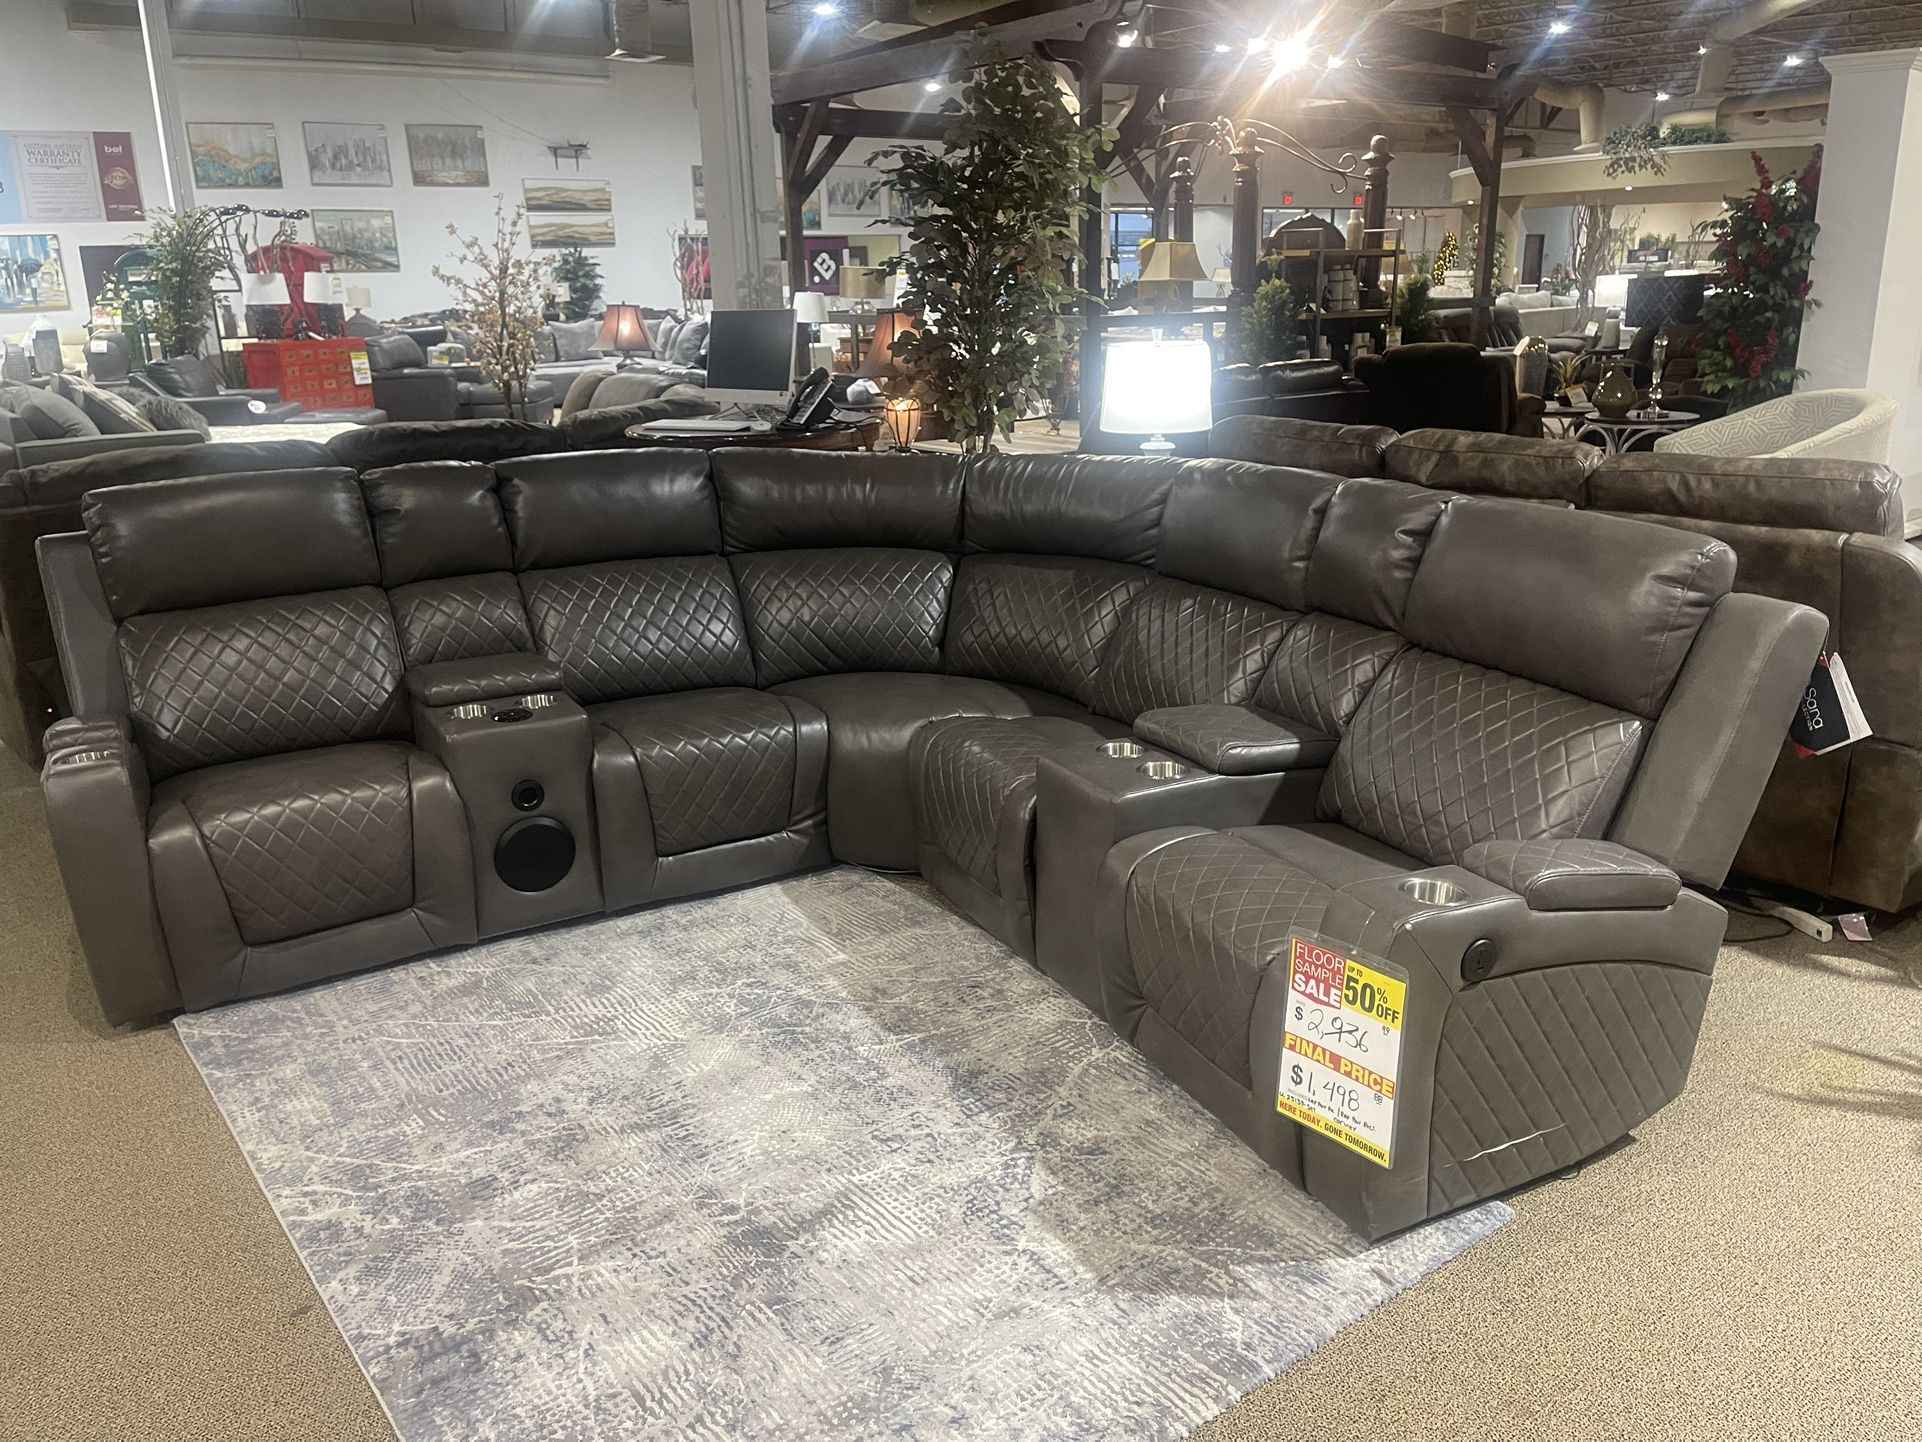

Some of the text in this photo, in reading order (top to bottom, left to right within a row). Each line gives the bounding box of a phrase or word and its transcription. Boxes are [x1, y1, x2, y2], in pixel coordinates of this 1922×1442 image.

[26, 149, 82, 159] WARRANTY
[28, 157, 82, 166] CERTIFICATE
[1804, 688, 1823, 728] Sara
[1296, 943, 1345, 973] FLOOR
[1348, 965, 1363, 977] UP TO
[1295, 960, 1344, 988] SAMPLE
[1294, 973, 1342, 1008] SALE
[1376, 1007, 1400, 1024] OFF
[1284, 1033, 1335, 1069] FINAL
[1339, 1058, 1394, 1099] PRICE
[1279, 1099, 1297, 1116] HERE
[1298, 1109, 1323, 1128] TODAY.
[1324, 1121, 1343, 1138] GONE
[1344, 1132, 1387, 1163] TOMORROW.
